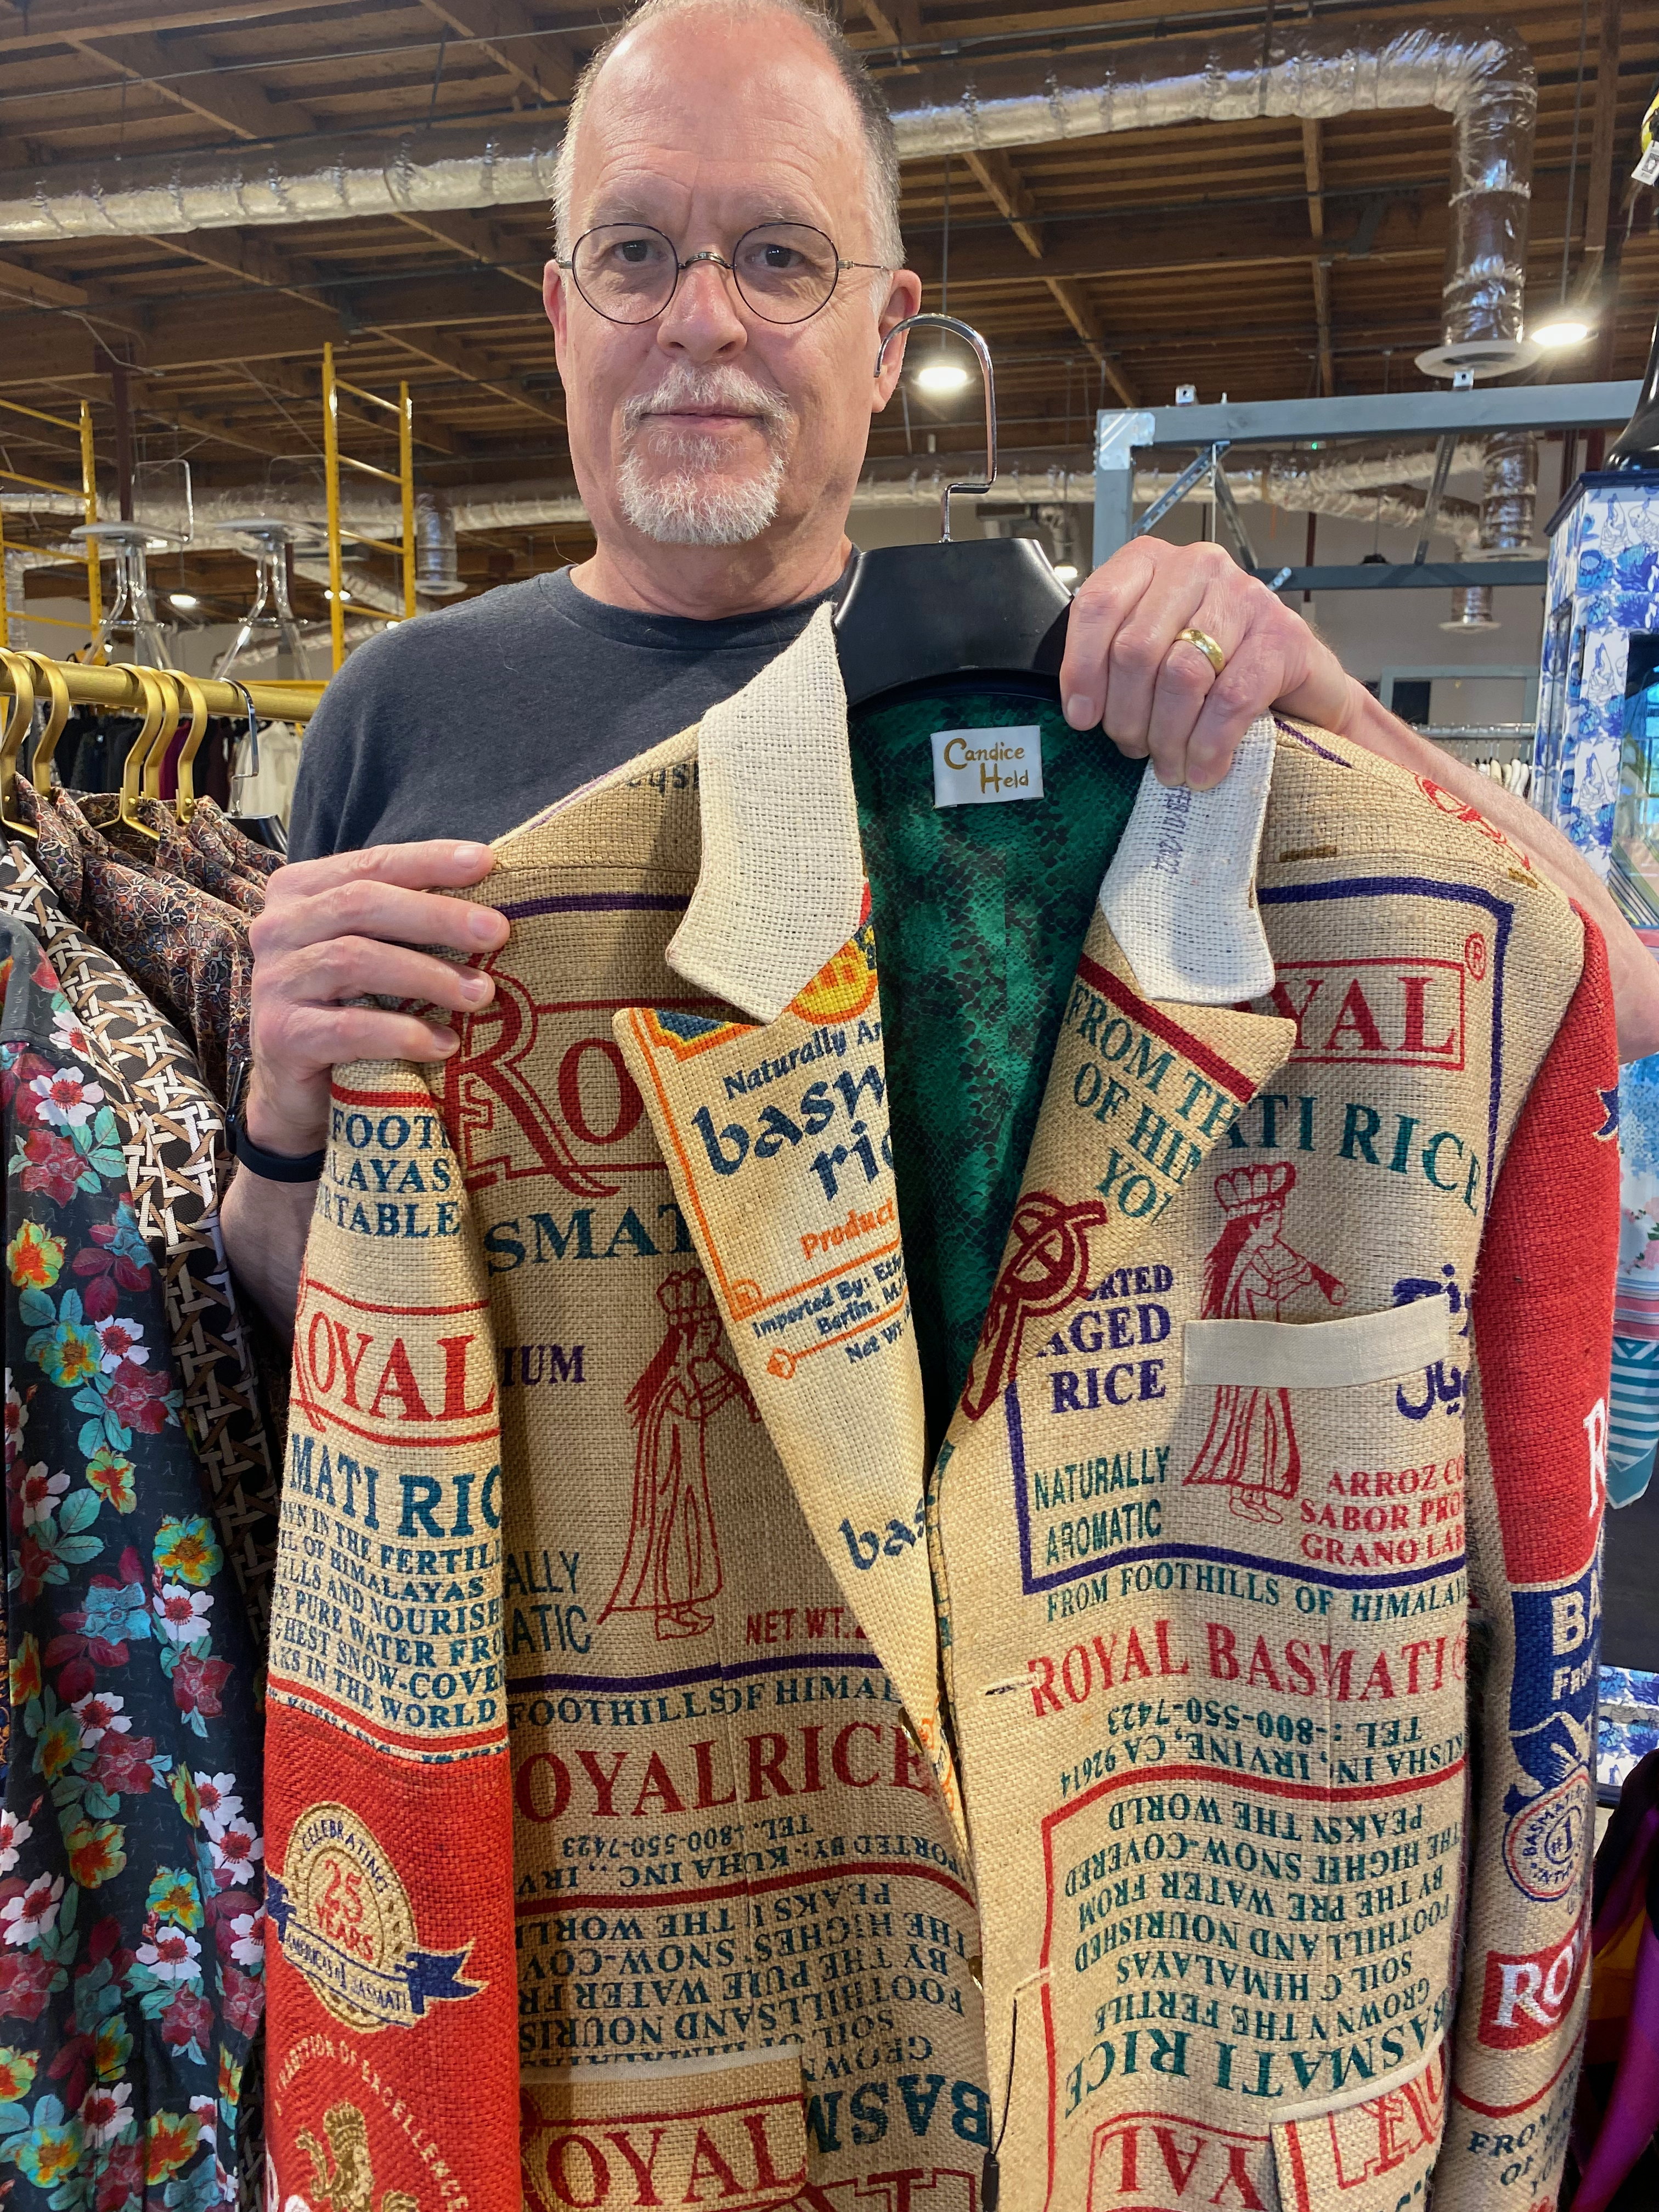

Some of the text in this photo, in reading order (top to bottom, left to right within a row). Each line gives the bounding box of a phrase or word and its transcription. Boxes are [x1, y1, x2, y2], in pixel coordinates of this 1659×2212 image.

[944, 738, 1025, 770] Candice
[980, 763, 1029, 794] Held
[722, 1029, 848, 1100] Naturally
[1067, 987, 1176, 1095] FROM
[1074, 1062, 1131, 1124] OF
[751, 1286, 835, 1339] Imported
[1035, 1302, 1171, 1358] AGED
[845, 1334, 881, 1364] Net
[1048, 1358, 1167, 1414] RICE
[290, 1432, 380, 1531] MATI
[1034, 1445, 1171, 1512] NATURALLY
[1327, 1463, 1437, 1498] ARROZ
[313, 1507, 330, 1536] IN
[335, 1520, 371, 1563] THE
[1046, 1498, 1163, 1566] AROMATIC
[1300, 1497, 1410, 1532] SABOR
[303, 1535, 326, 1559] OF
[329, 1545, 484, 1603] HIMALAYAS
[1300, 1532, 1419, 1568] GRANO
[328, 1575, 364, 1614] AND
[1047, 1572, 1108, 1622] FROM
[1121, 1561, 1280, 1607] FOOTHILLS
[1295, 1584, 1334, 1615] OF
[296, 1589, 343, 1634] PURE
[349, 1614, 437, 1668] WATER
[746, 1607, 797, 1646] NET
[307, 1654, 327, 1684] IN
[332, 1667, 375, 1711] THE
[381, 1696, 497, 1729] WORLD
[1027, 1620, 1189, 1718] ROYAL
[1206, 1622, 1448, 1702] BASMATI
[1122, 1734, 1166, 1764] CA
[1173, 1728, 1311, 1780] IRVINE,
[1356, 1716, 1424, 1750] TEL
[1060, 1744, 1117, 1798] 92614
[1108, 1793, 1223, 1831] WORLD
[1232, 1801, 1302, 1842] THE
[302, 1819, 388, 1893] CELEBRATING
[1064, 1831, 1302, 1898] SNOW-COVERED
[324, 1858, 364, 1923] 25
[774, 1882, 891, 1922] PEAKS
[1078, 1872, 1147, 1933] FROM
[1160, 1871, 1275, 1918] WATER
[1355, 1878, 1413, 1918] THE
[1418, 1865, 1443, 1899] BY
[657, 1907, 737, 1939] THE
[907, 1912, 967, 1960] THE
[1074, 1910, 1238, 1973] NOURISHED
[1249, 1928, 1319, 1961] AND
[821, 1945, 893, 1984] THE
[905, 1942, 949, 1977] BY
[1116, 1950, 1310, 2002] HIMALAYAS
[1351, 1949, 1413, 1994] SOIL
[575, 1977, 711, 2011] WATER
[758, 1973, 966, 2032] FOOTHILLS
[1093, 1990, 1219, 2036] FERTILE
[1337, 1977, 1431, 2037] GROWN
[674, 2006, 754, 2033] AND
[812, 2009, 895, 2050] SOIL
[1229, 2005, 1298, 2042] THE
[1064, 2029, 1192, 2119] RICE
[362, 2059, 470, 2212] EXCELLENCE
